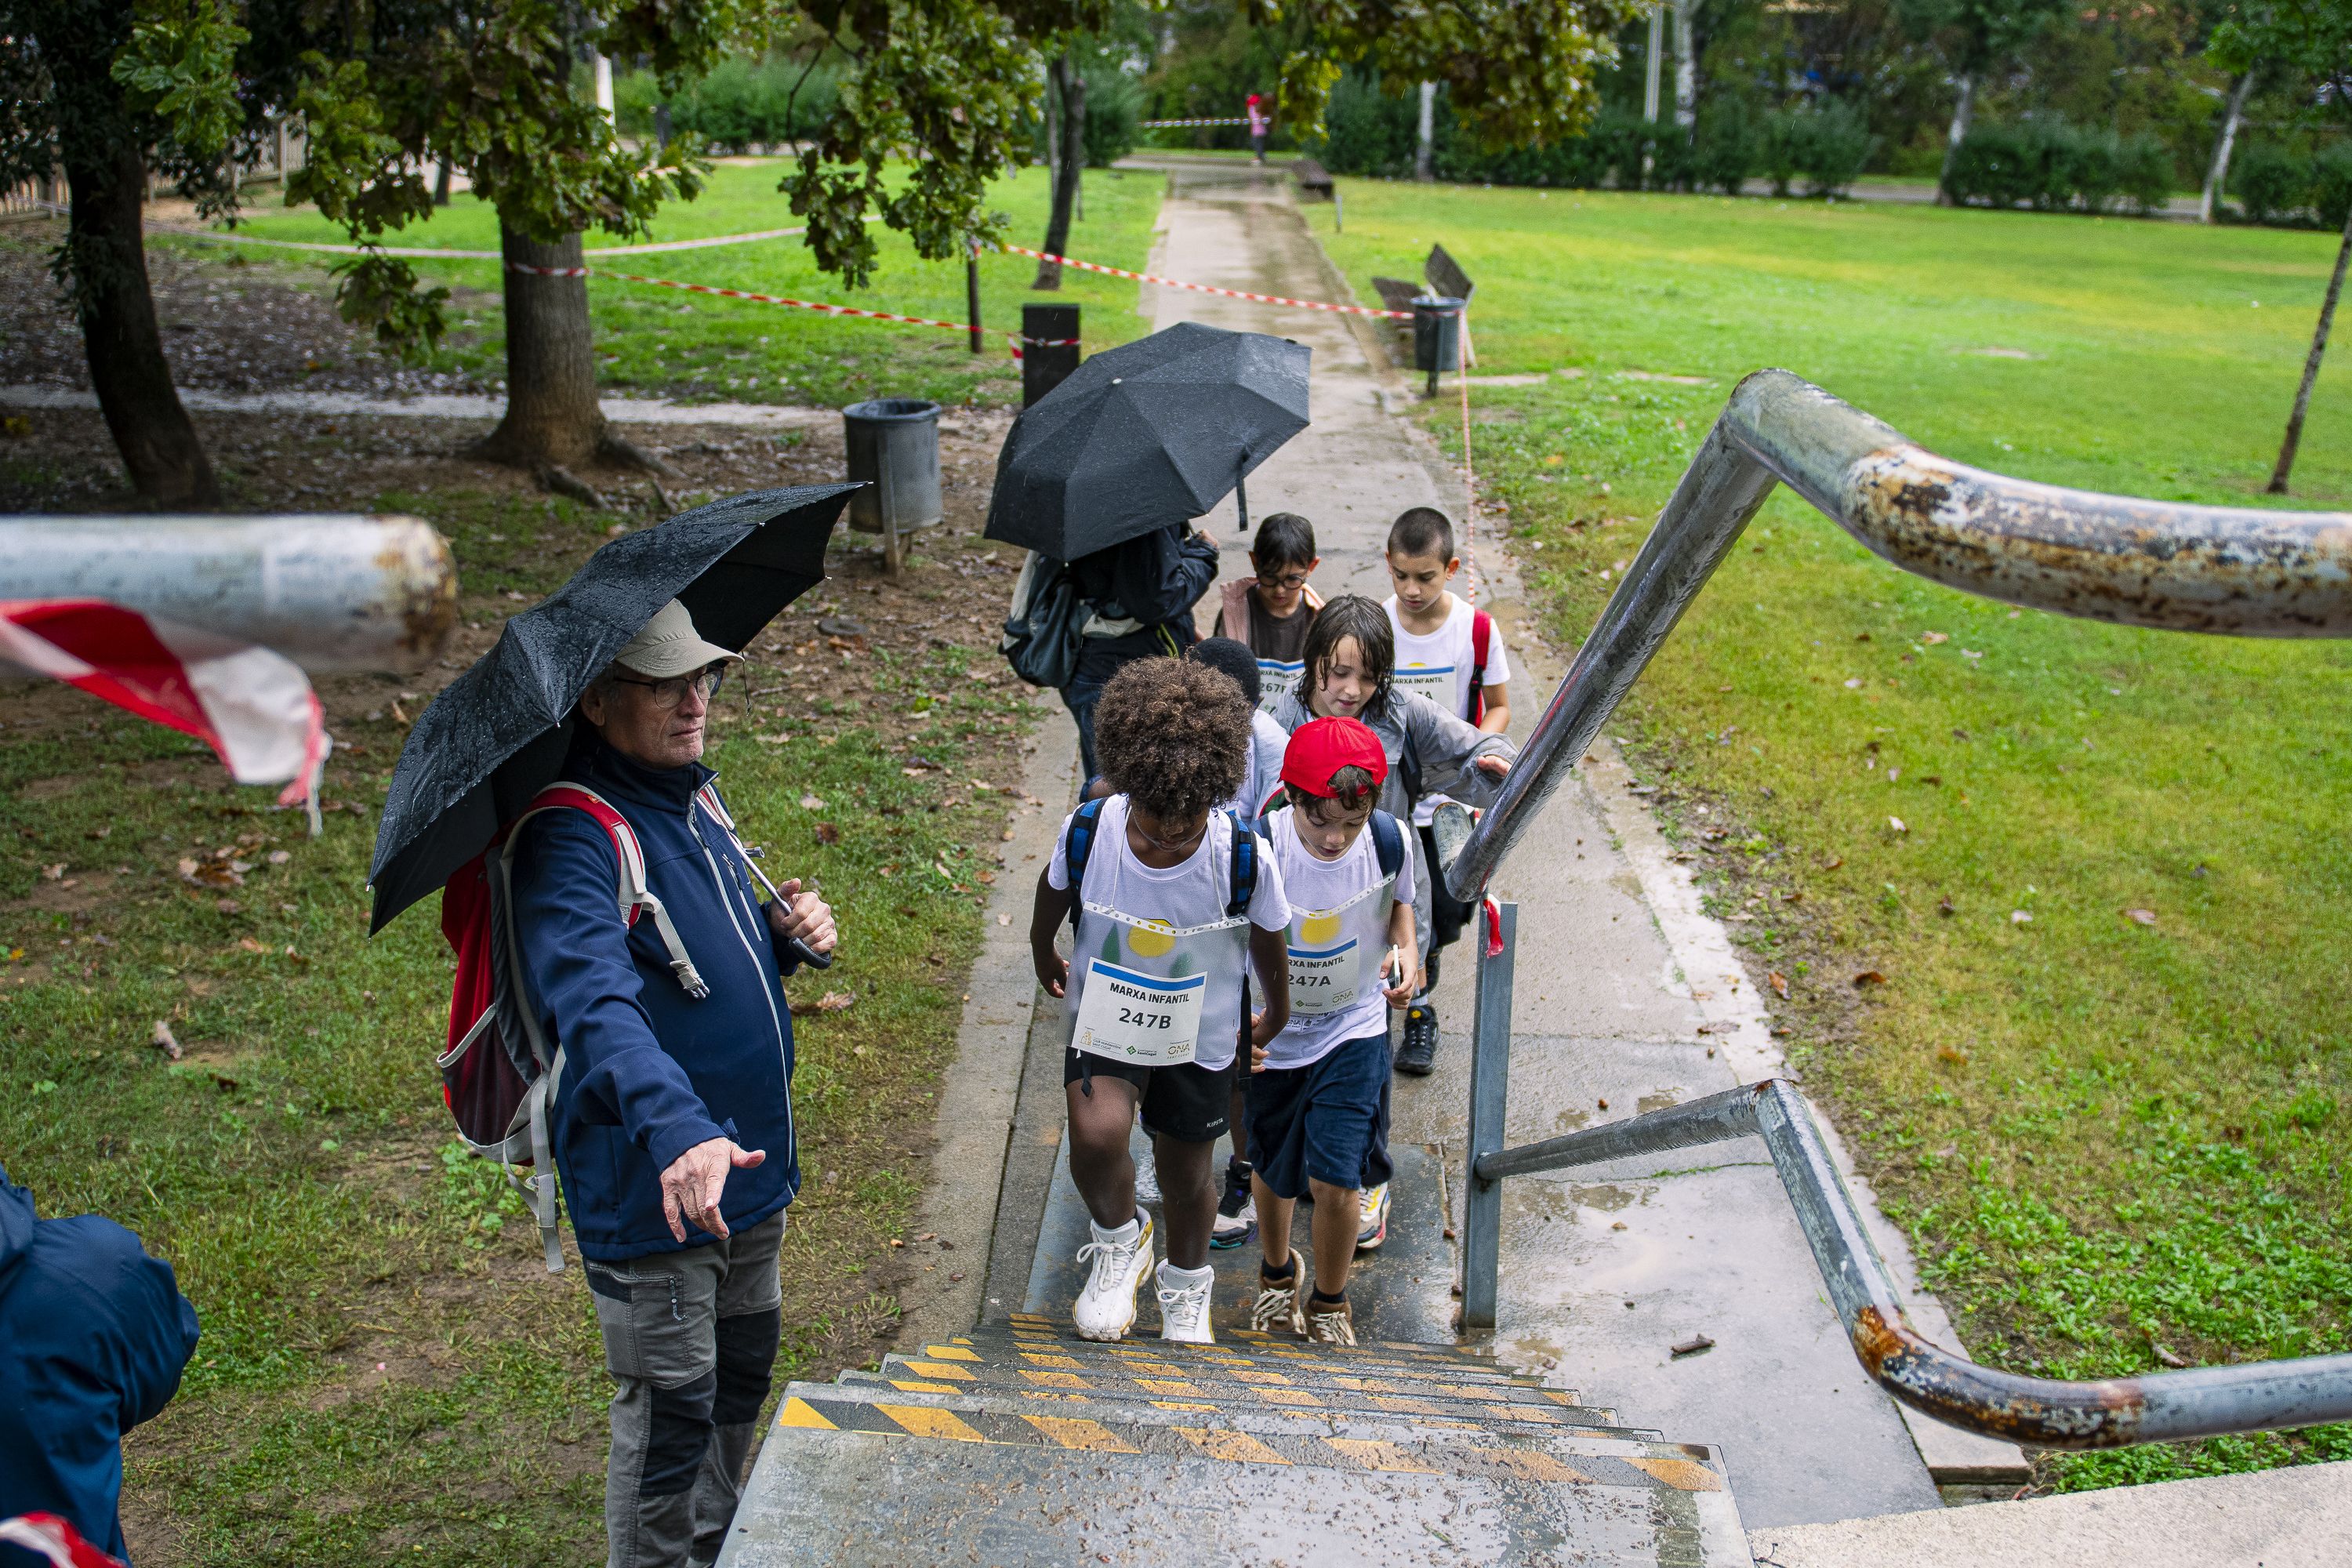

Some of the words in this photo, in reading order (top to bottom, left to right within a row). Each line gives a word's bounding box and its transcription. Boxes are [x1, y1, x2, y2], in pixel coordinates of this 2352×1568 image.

[1288, 959, 1305, 967] RXA
[1307, 956, 1345, 968] INFANTIL
[1288, 975, 1331, 987] 247A
[1110, 982, 1146, 1001] MARXA
[1149, 993, 1189, 1004] INFANTIL
[1333, 990, 1354, 1004] ONA
[1119, 1007, 1172, 1029] 247B
[1168, 1044, 1190, 1054] ONA
